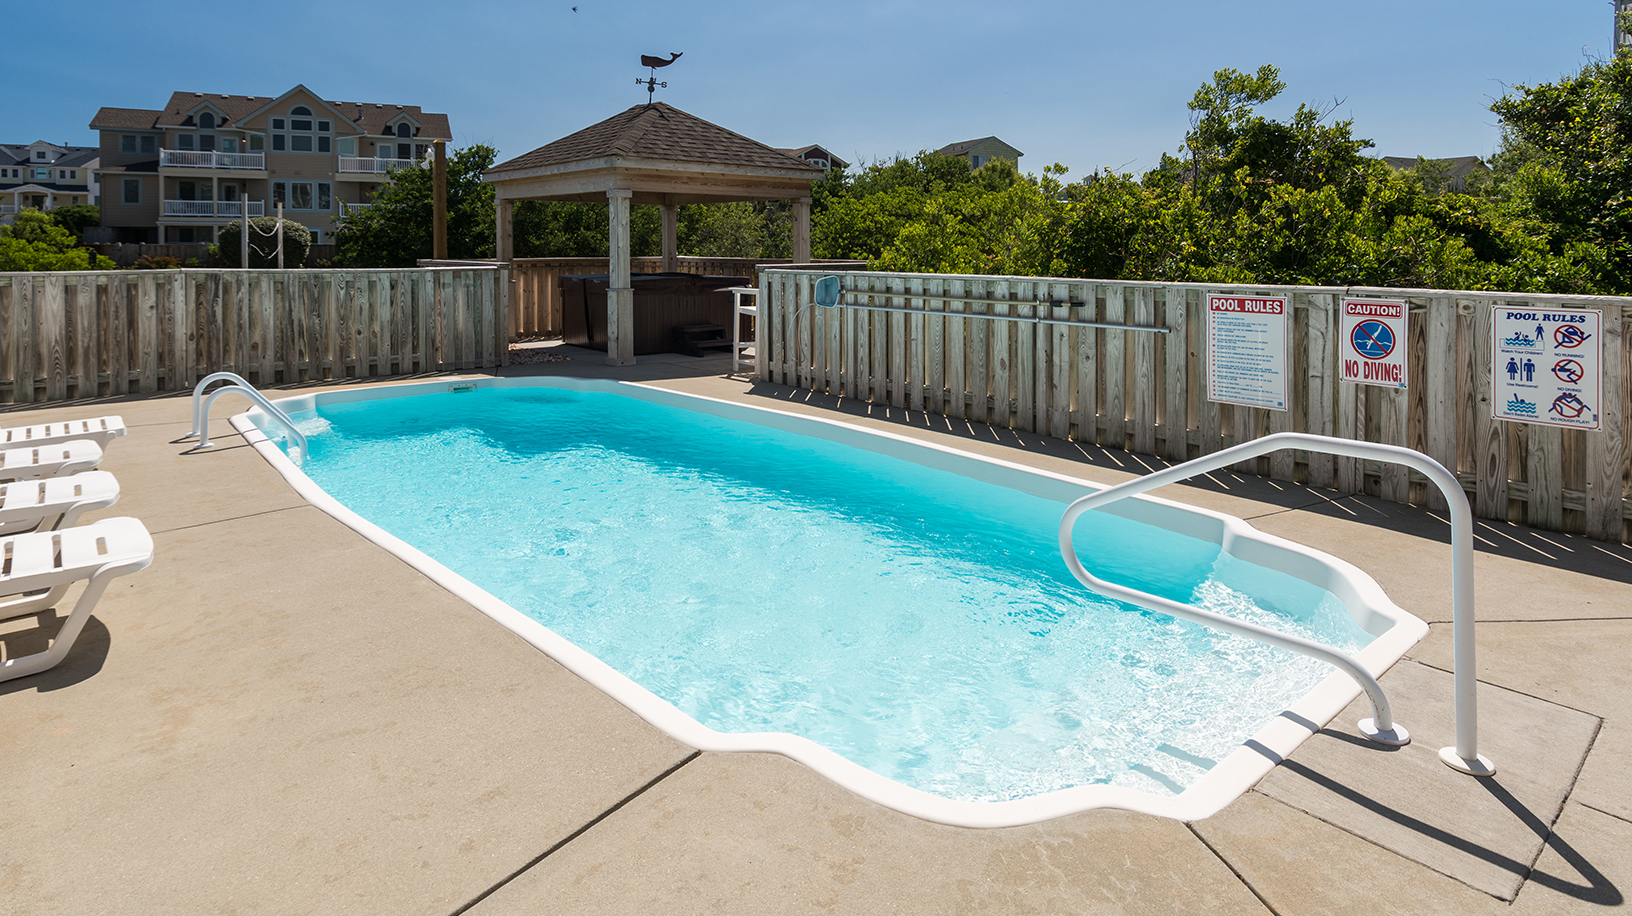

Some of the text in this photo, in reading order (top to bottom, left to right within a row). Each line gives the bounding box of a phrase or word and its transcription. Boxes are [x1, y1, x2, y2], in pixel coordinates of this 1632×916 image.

[635, 77, 642, 85] N
[1212, 299, 1281, 313] POOL RULES
[1347, 304, 1400, 316] CAUTION!
[1506, 312, 1587, 323] POOL RULES
[1345, 359, 1402, 383] NO DIVING!
